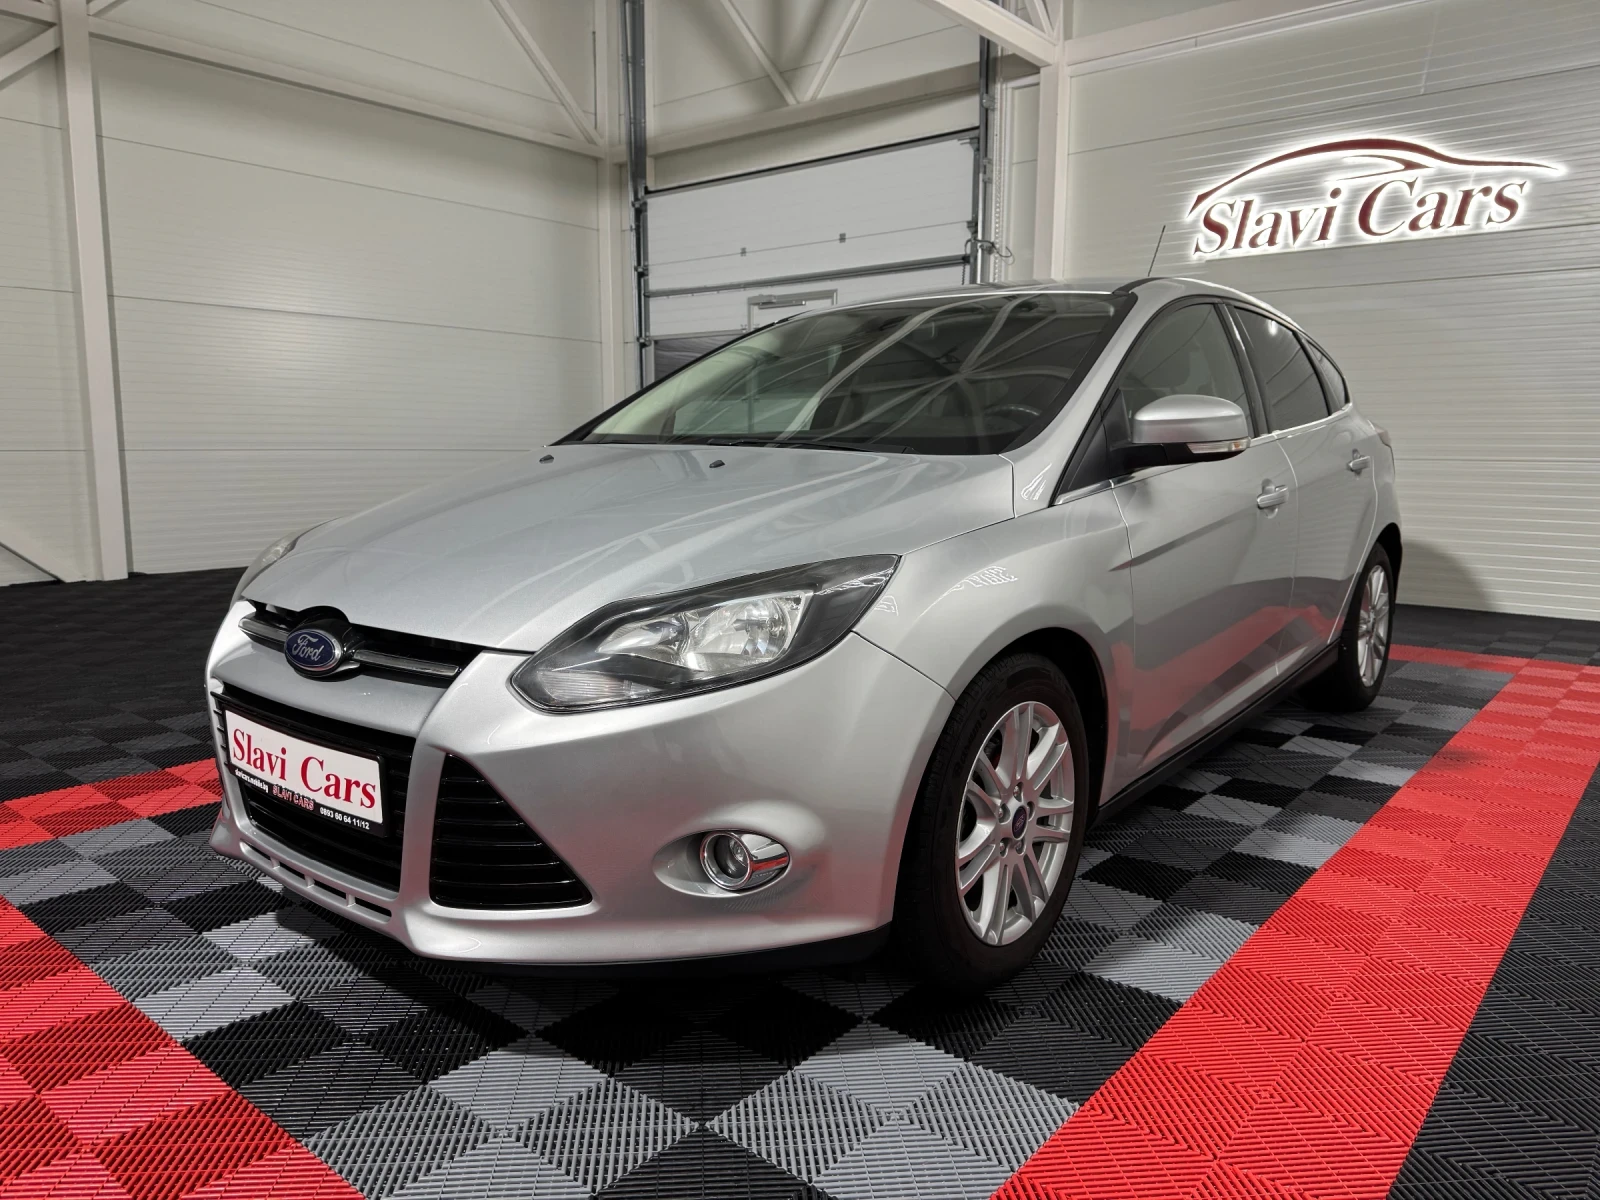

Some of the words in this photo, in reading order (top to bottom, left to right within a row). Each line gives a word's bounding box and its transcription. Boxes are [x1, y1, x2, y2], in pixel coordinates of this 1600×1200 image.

[1192, 187, 1342, 256] Slavi
[1358, 175, 1528, 237] Cars
[292, 634, 325, 661] Ford
[233, 728, 287, 781] Slavi
[301, 756, 376, 809] Cars
[272, 784, 293, 803] SLAVI
[293, 793, 315, 811] CARS
[319, 807, 334, 819] 0893
[343, 815, 352, 824] 64
[352, 818, 370, 830] 11/12
